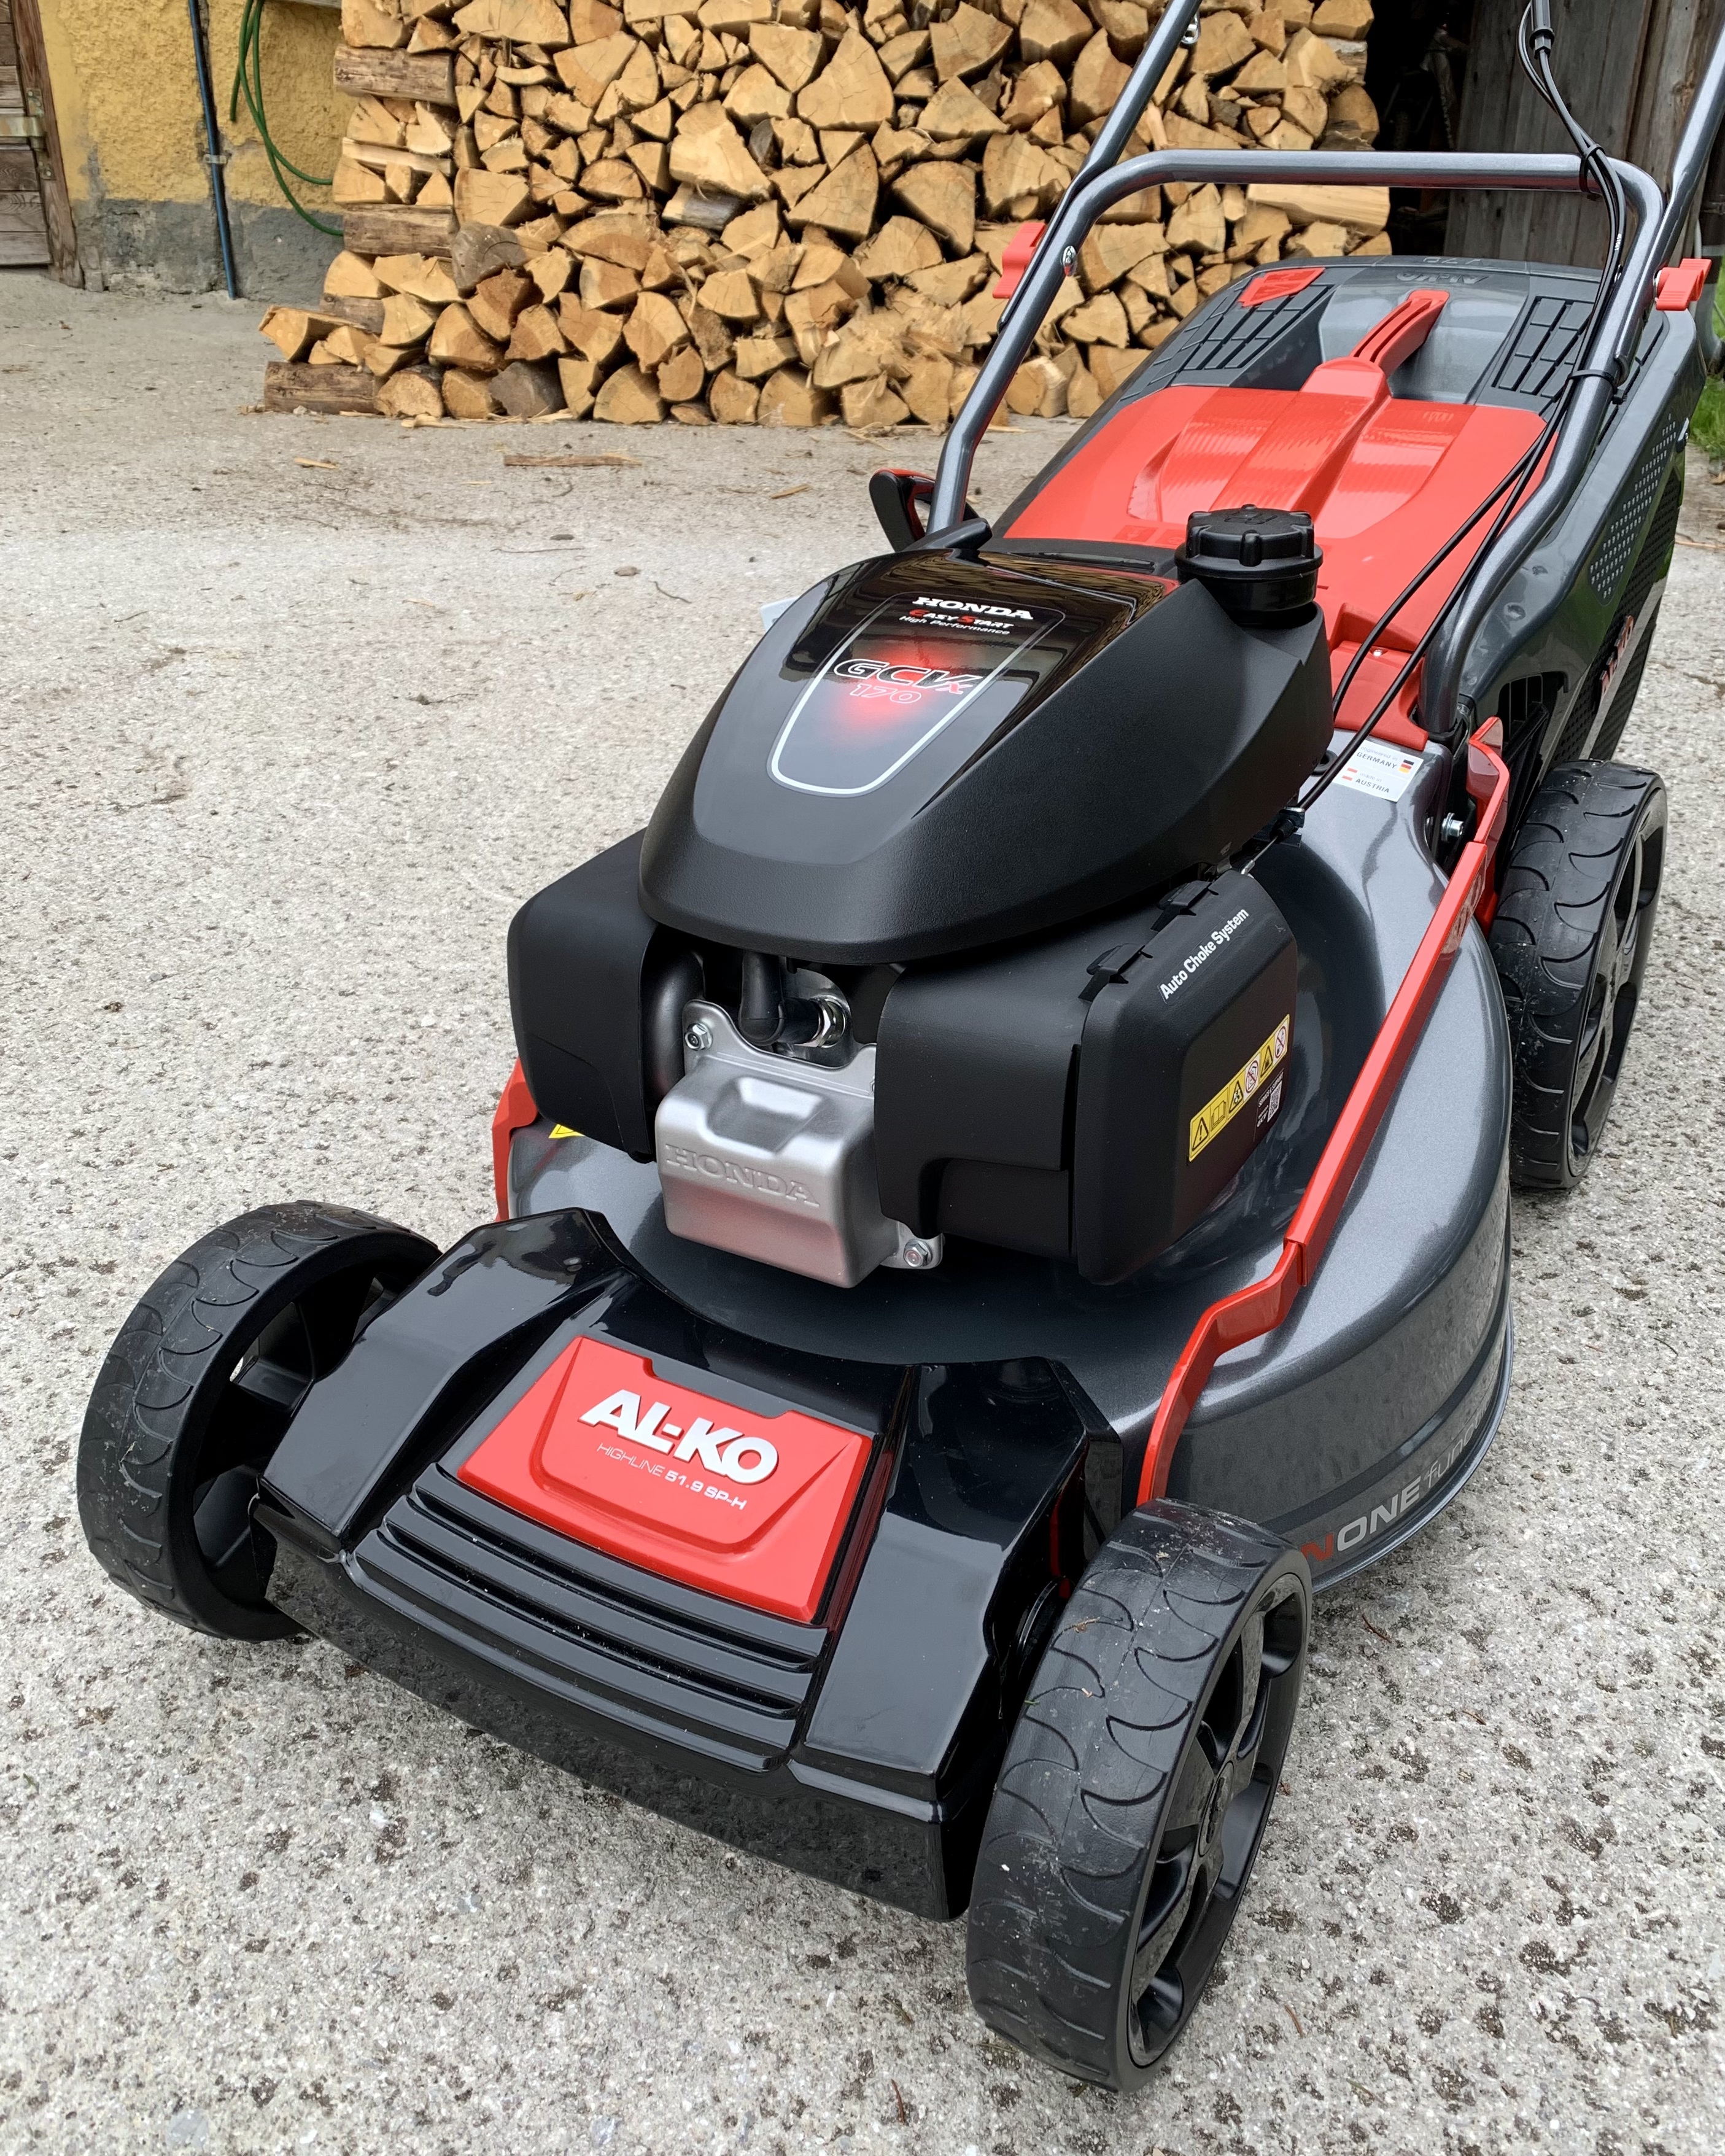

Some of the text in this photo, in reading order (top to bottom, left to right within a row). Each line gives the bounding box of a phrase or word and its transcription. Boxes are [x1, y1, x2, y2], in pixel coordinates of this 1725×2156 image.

[912, 597, 1033, 619] HONDA
[899, 616, 1010, 635] High Performance
[849, 683, 921, 704] 170
[1356, 751, 1397, 769] GERMANY
[1360, 746, 1391, 759] engineered
[1355, 778, 1390, 793] AUSTRIA
[1360, 772, 1375, 781] made
[1160, 907, 1249, 999] Auto Choke System
[665, 1144, 820, 1208] HONDA
[578, 1389, 779, 1484] AL-KO
[597, 1443, 748, 1510] HIGHLINE 51.9 SP-H
